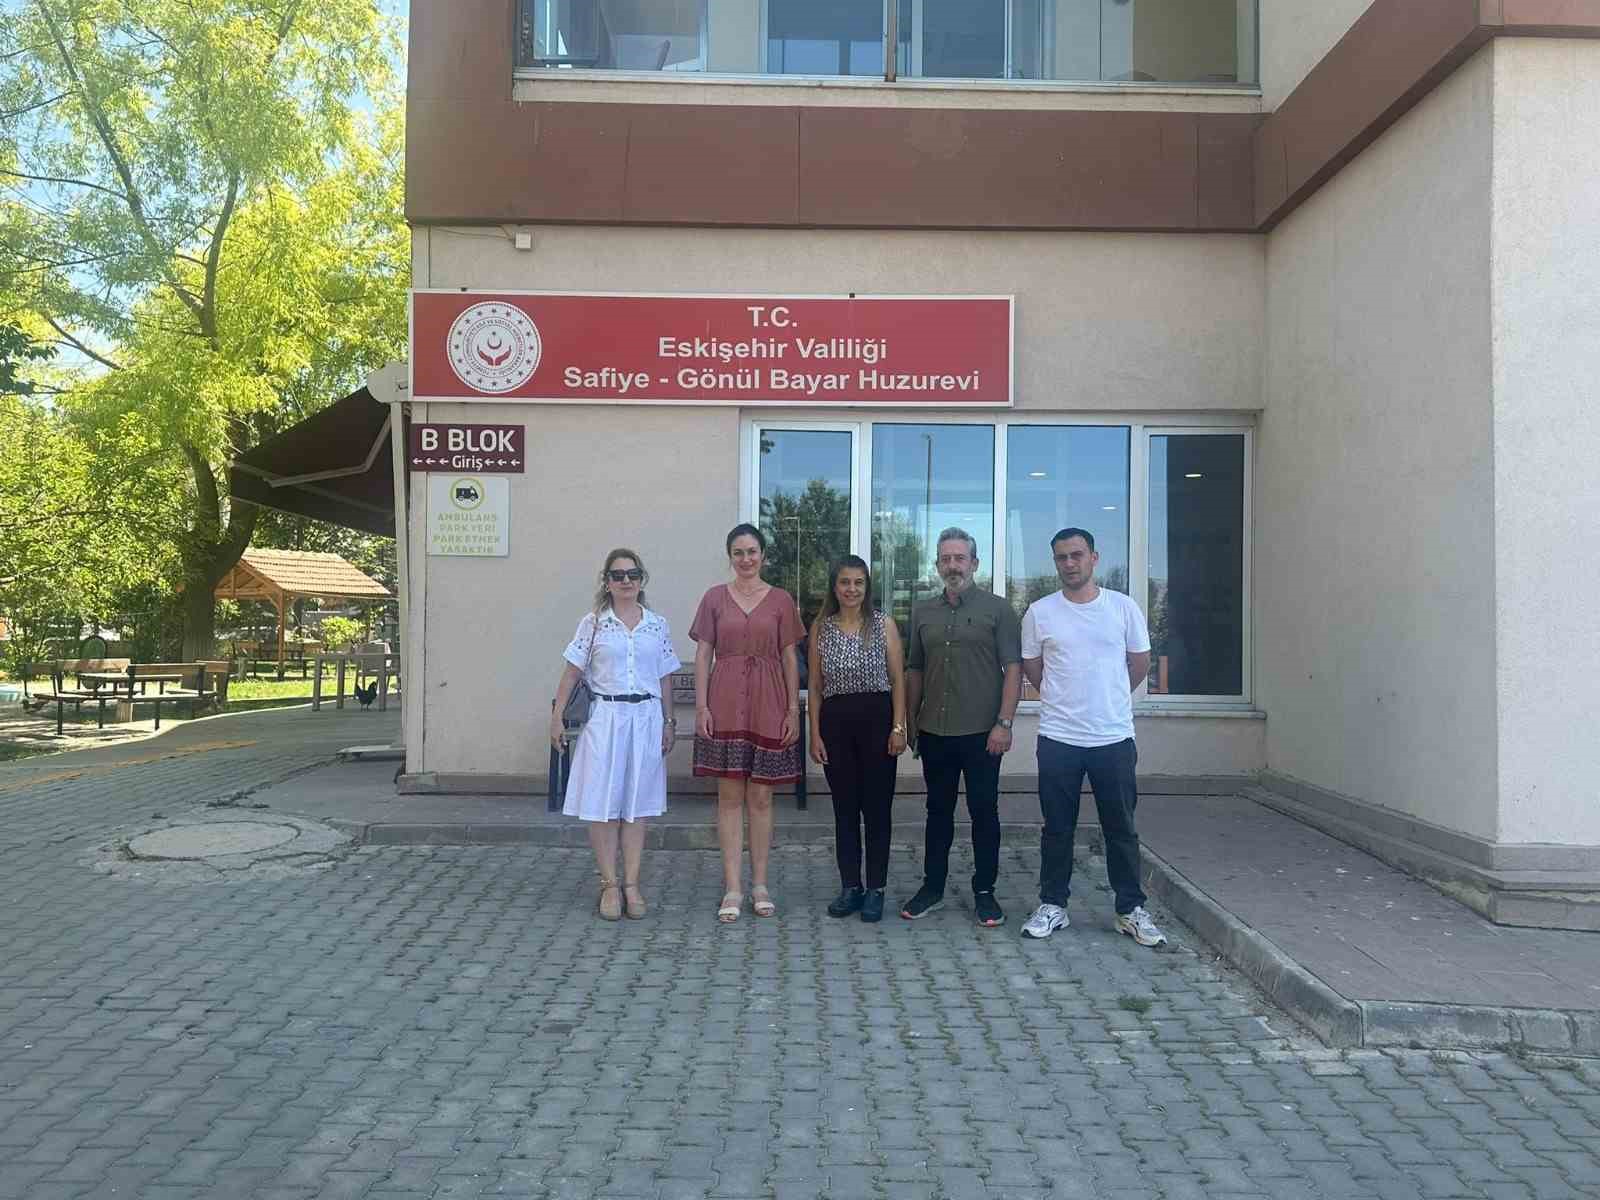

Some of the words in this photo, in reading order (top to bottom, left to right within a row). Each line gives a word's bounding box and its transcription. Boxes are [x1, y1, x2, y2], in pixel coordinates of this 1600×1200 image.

[747, 307, 799, 327] T.C.
[659, 336, 788, 363] Eskişehir
[796, 338, 887, 364] Valiliği
[563, 366, 650, 392] Safiye
[677, 368, 760, 389] Gönül
[770, 369, 849, 394] Bayar
[859, 370, 979, 390] Huzurevi
[421, 428, 438, 451] B
[448, 428, 515, 452] BLOK
[452, 455, 483, 471] Giriş
[438, 512, 498, 521] AMBULANS
[440, 524, 469, 532] PARK
[432, 535, 463, 543] PARK
[465, 535, 501, 543] ETMEK
